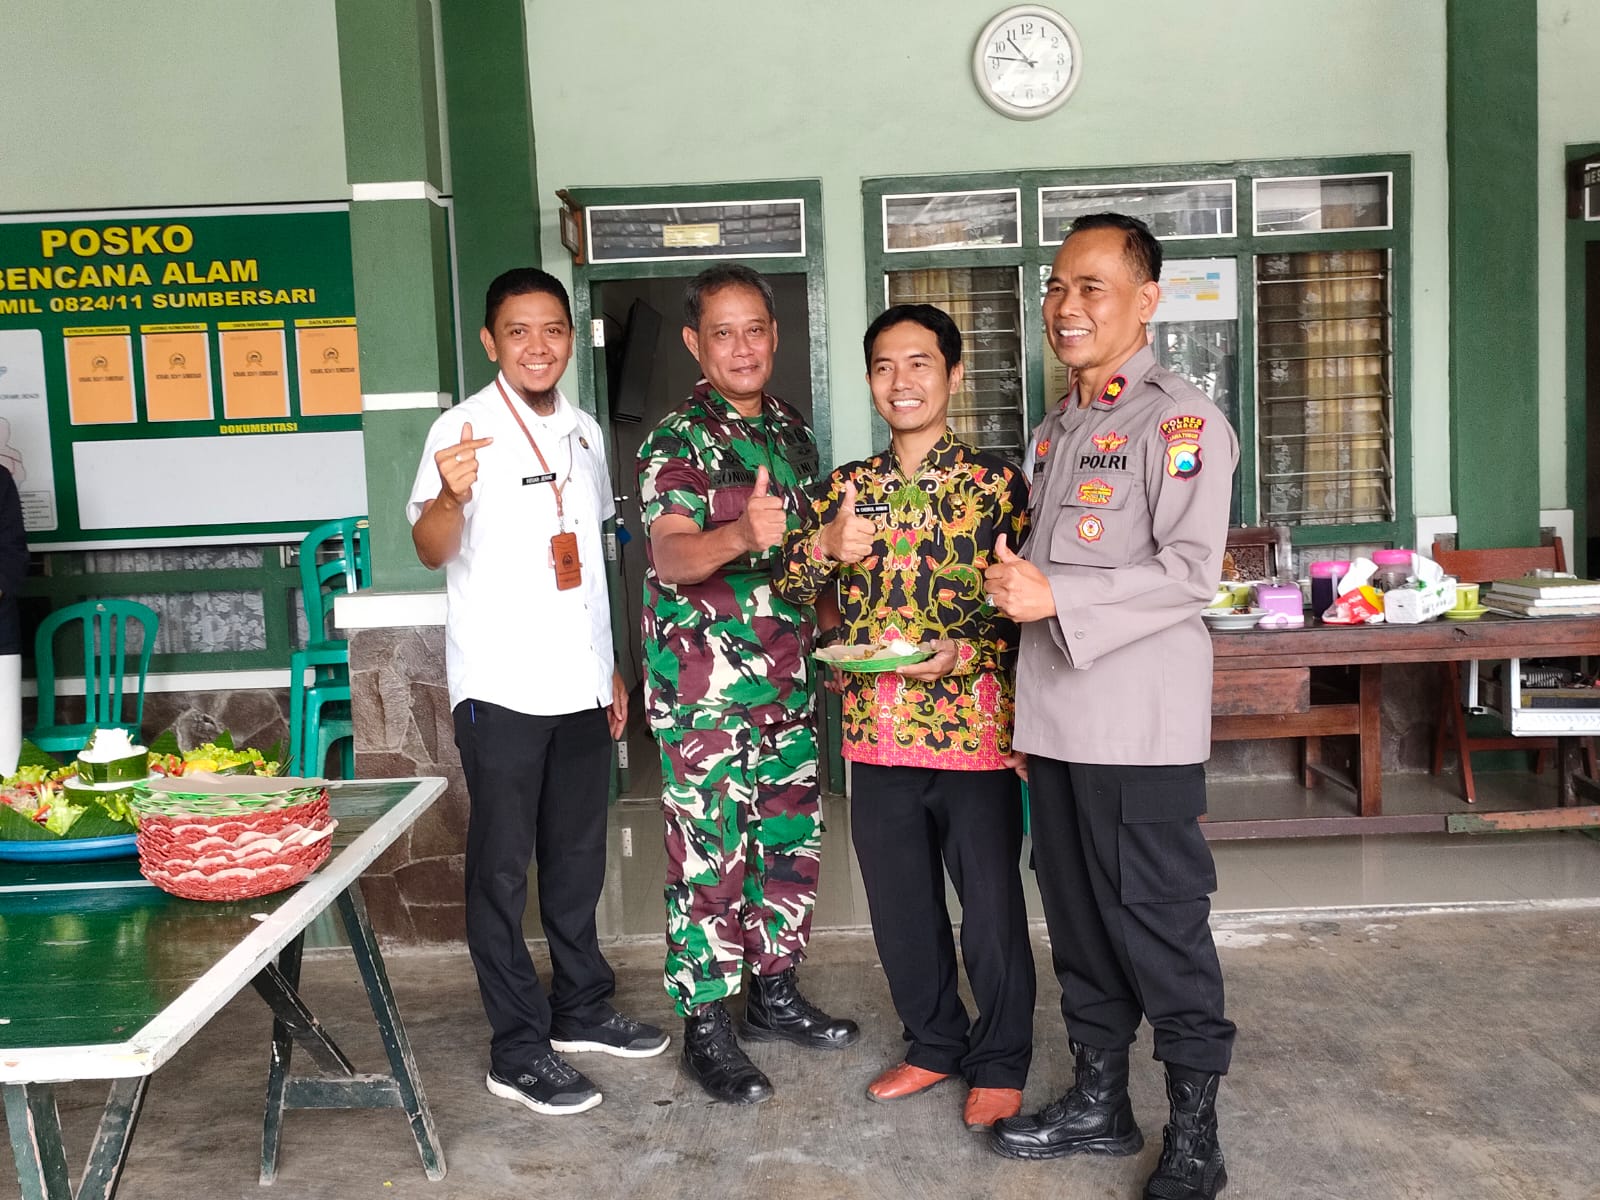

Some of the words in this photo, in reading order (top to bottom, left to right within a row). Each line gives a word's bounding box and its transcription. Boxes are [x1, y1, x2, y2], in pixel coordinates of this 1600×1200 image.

[1006, 29, 1017, 40] 11
[1021, 23, 1033, 35] 12
[1041, 26, 1046, 38] 1
[995, 41, 1006, 53] 10
[1051, 36, 1059, 49] 2
[41, 225, 194, 257] POSKO
[0, 263, 153, 291] ENCANA
[162, 259, 259, 285] ALAM
[49, 294, 143, 313] 0824/11
[152, 288, 316, 309] SUMBERSARI
[219, 422, 298, 434] DOKUMENTASI
[1162, 416, 1203, 432] POLRES
[1079, 454, 1128, 470] POLRI
